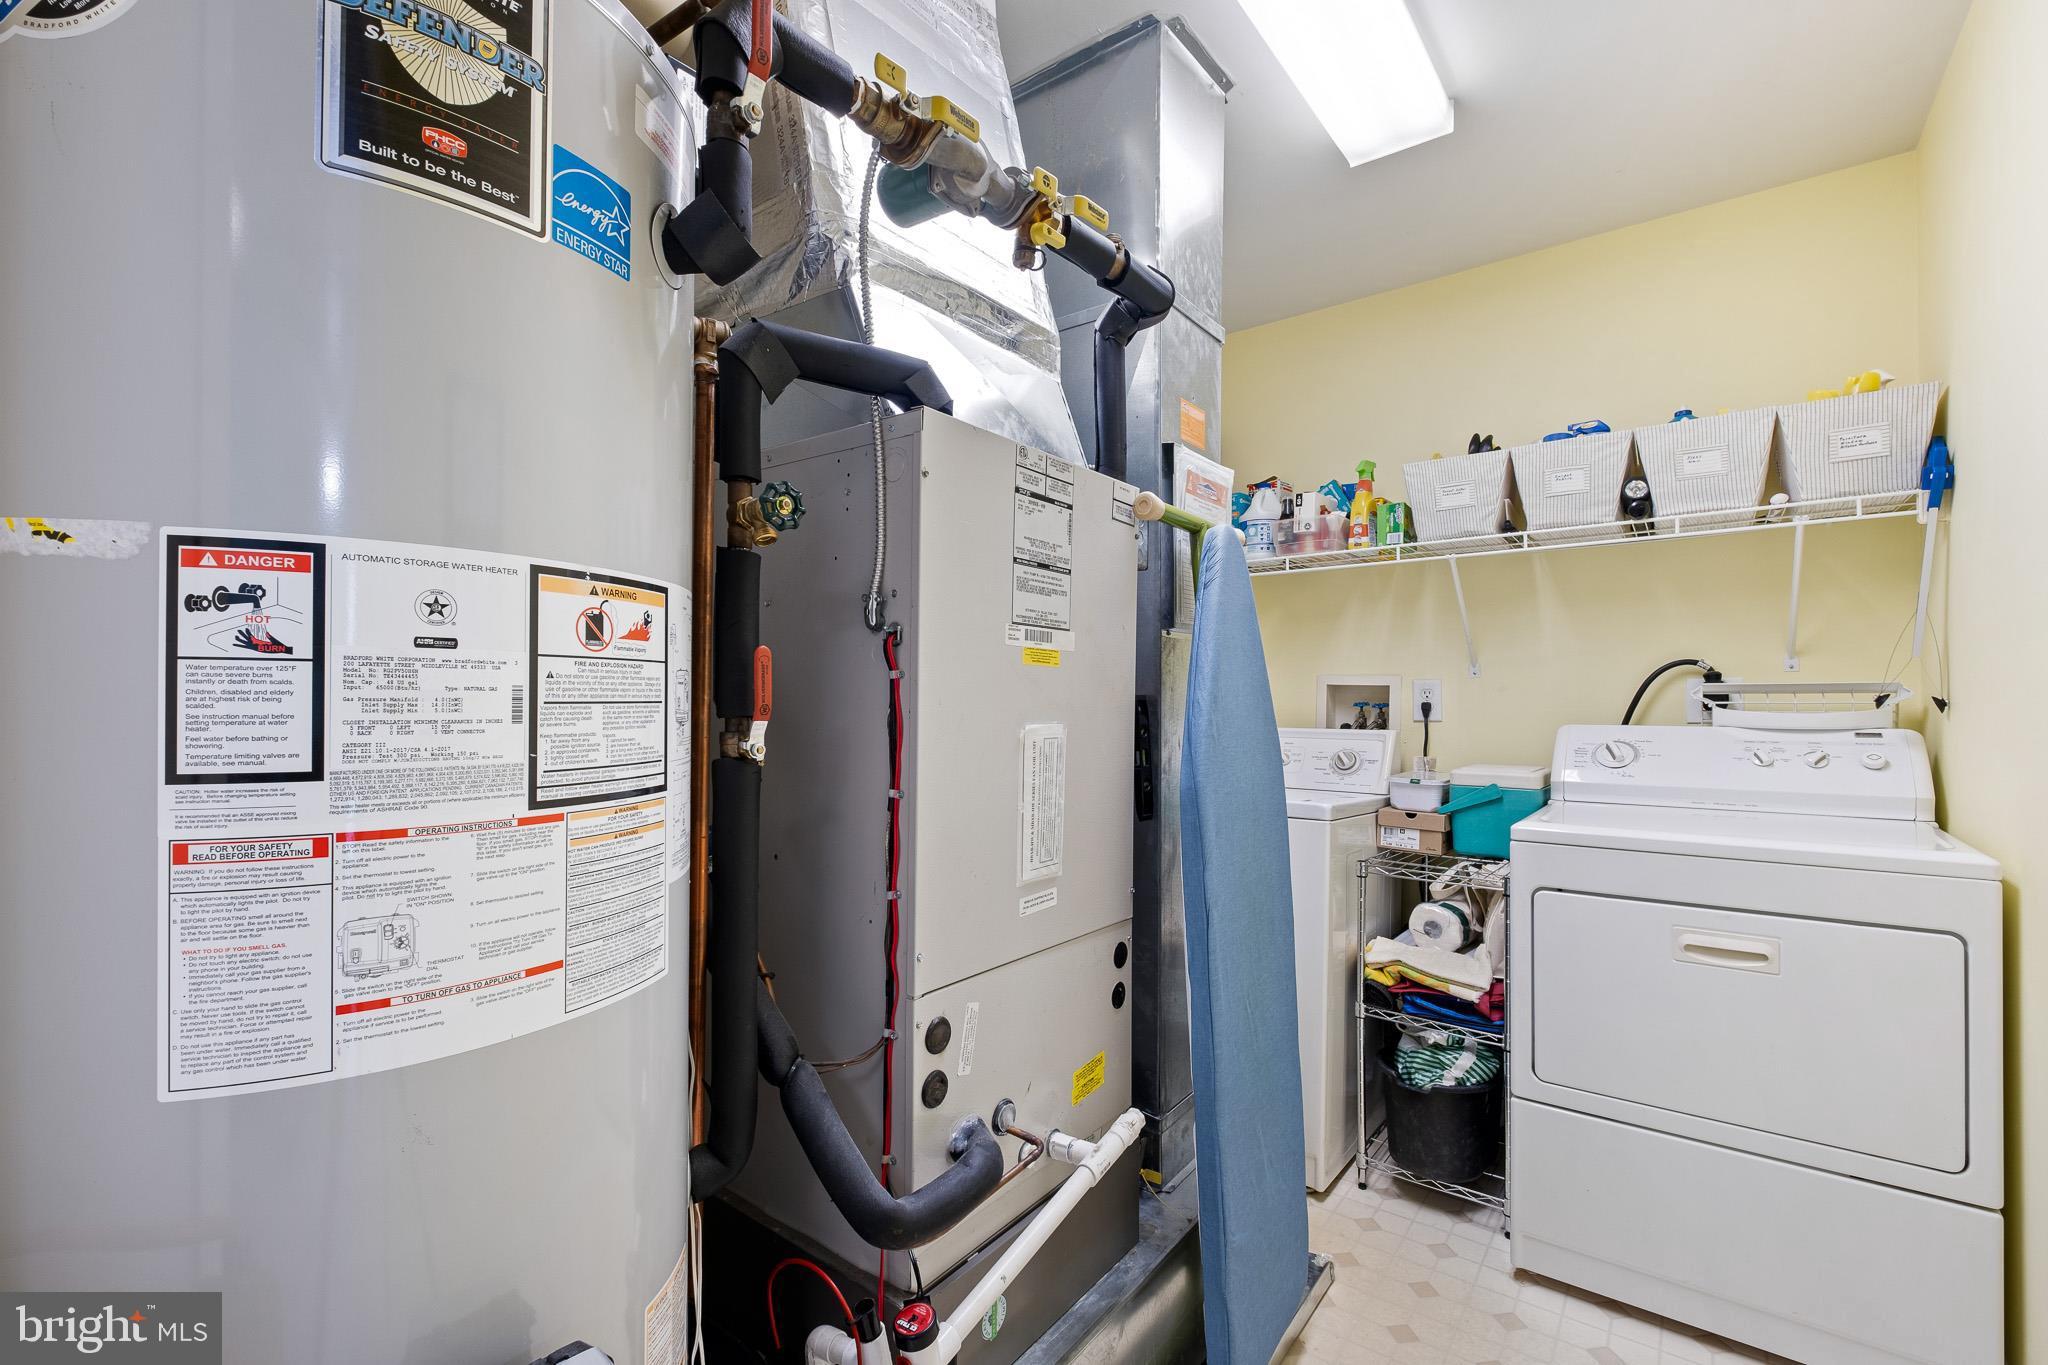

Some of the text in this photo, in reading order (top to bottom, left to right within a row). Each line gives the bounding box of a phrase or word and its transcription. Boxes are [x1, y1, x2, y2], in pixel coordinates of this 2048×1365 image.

[23, 18, 79, 29] BRADFORD
[85, 0, 117, 20] WHITE
[337, 0, 546, 94] DEFENDER
[364, 24, 440, 63] SAFETY
[361, 83, 518, 149] ENERGY SAVER
[424, 129, 467, 151] PHCC
[358, 139, 398, 161] Built
[401, 151, 420, 168] to
[424, 159, 446, 176] be
[450, 170, 477, 188] the
[554, 192, 609, 233] energy
[556, 227, 628, 279] ENERGY STAR
[224, 553, 296, 569] DANGER
[341, 553, 519, 576] AUTOMATIC STORAGE WATER HEATER
[600, 587, 637, 601] WARNING
[245, 615, 271, 624] HOT
[257, 644, 285, 653] BURN
[600, 661, 627, 669] EXPLOSION
[618, 805, 639, 814] WARNING
[414, 820, 513, 836] OPERATING INSTRUCTIONS
[192, 848, 310, 862] READ BEFORE OPERATING
[209, 842, 293, 853] FOR YOUR SAFETY
[406, 892, 452, 903] SWITCH SHOWN
[427, 898, 455, 906] POSITION
[427, 955, 465, 966] THERMOSTAT
[402, 972, 522, 1004] TO TURN OFF GAS TO APPLIANCE
